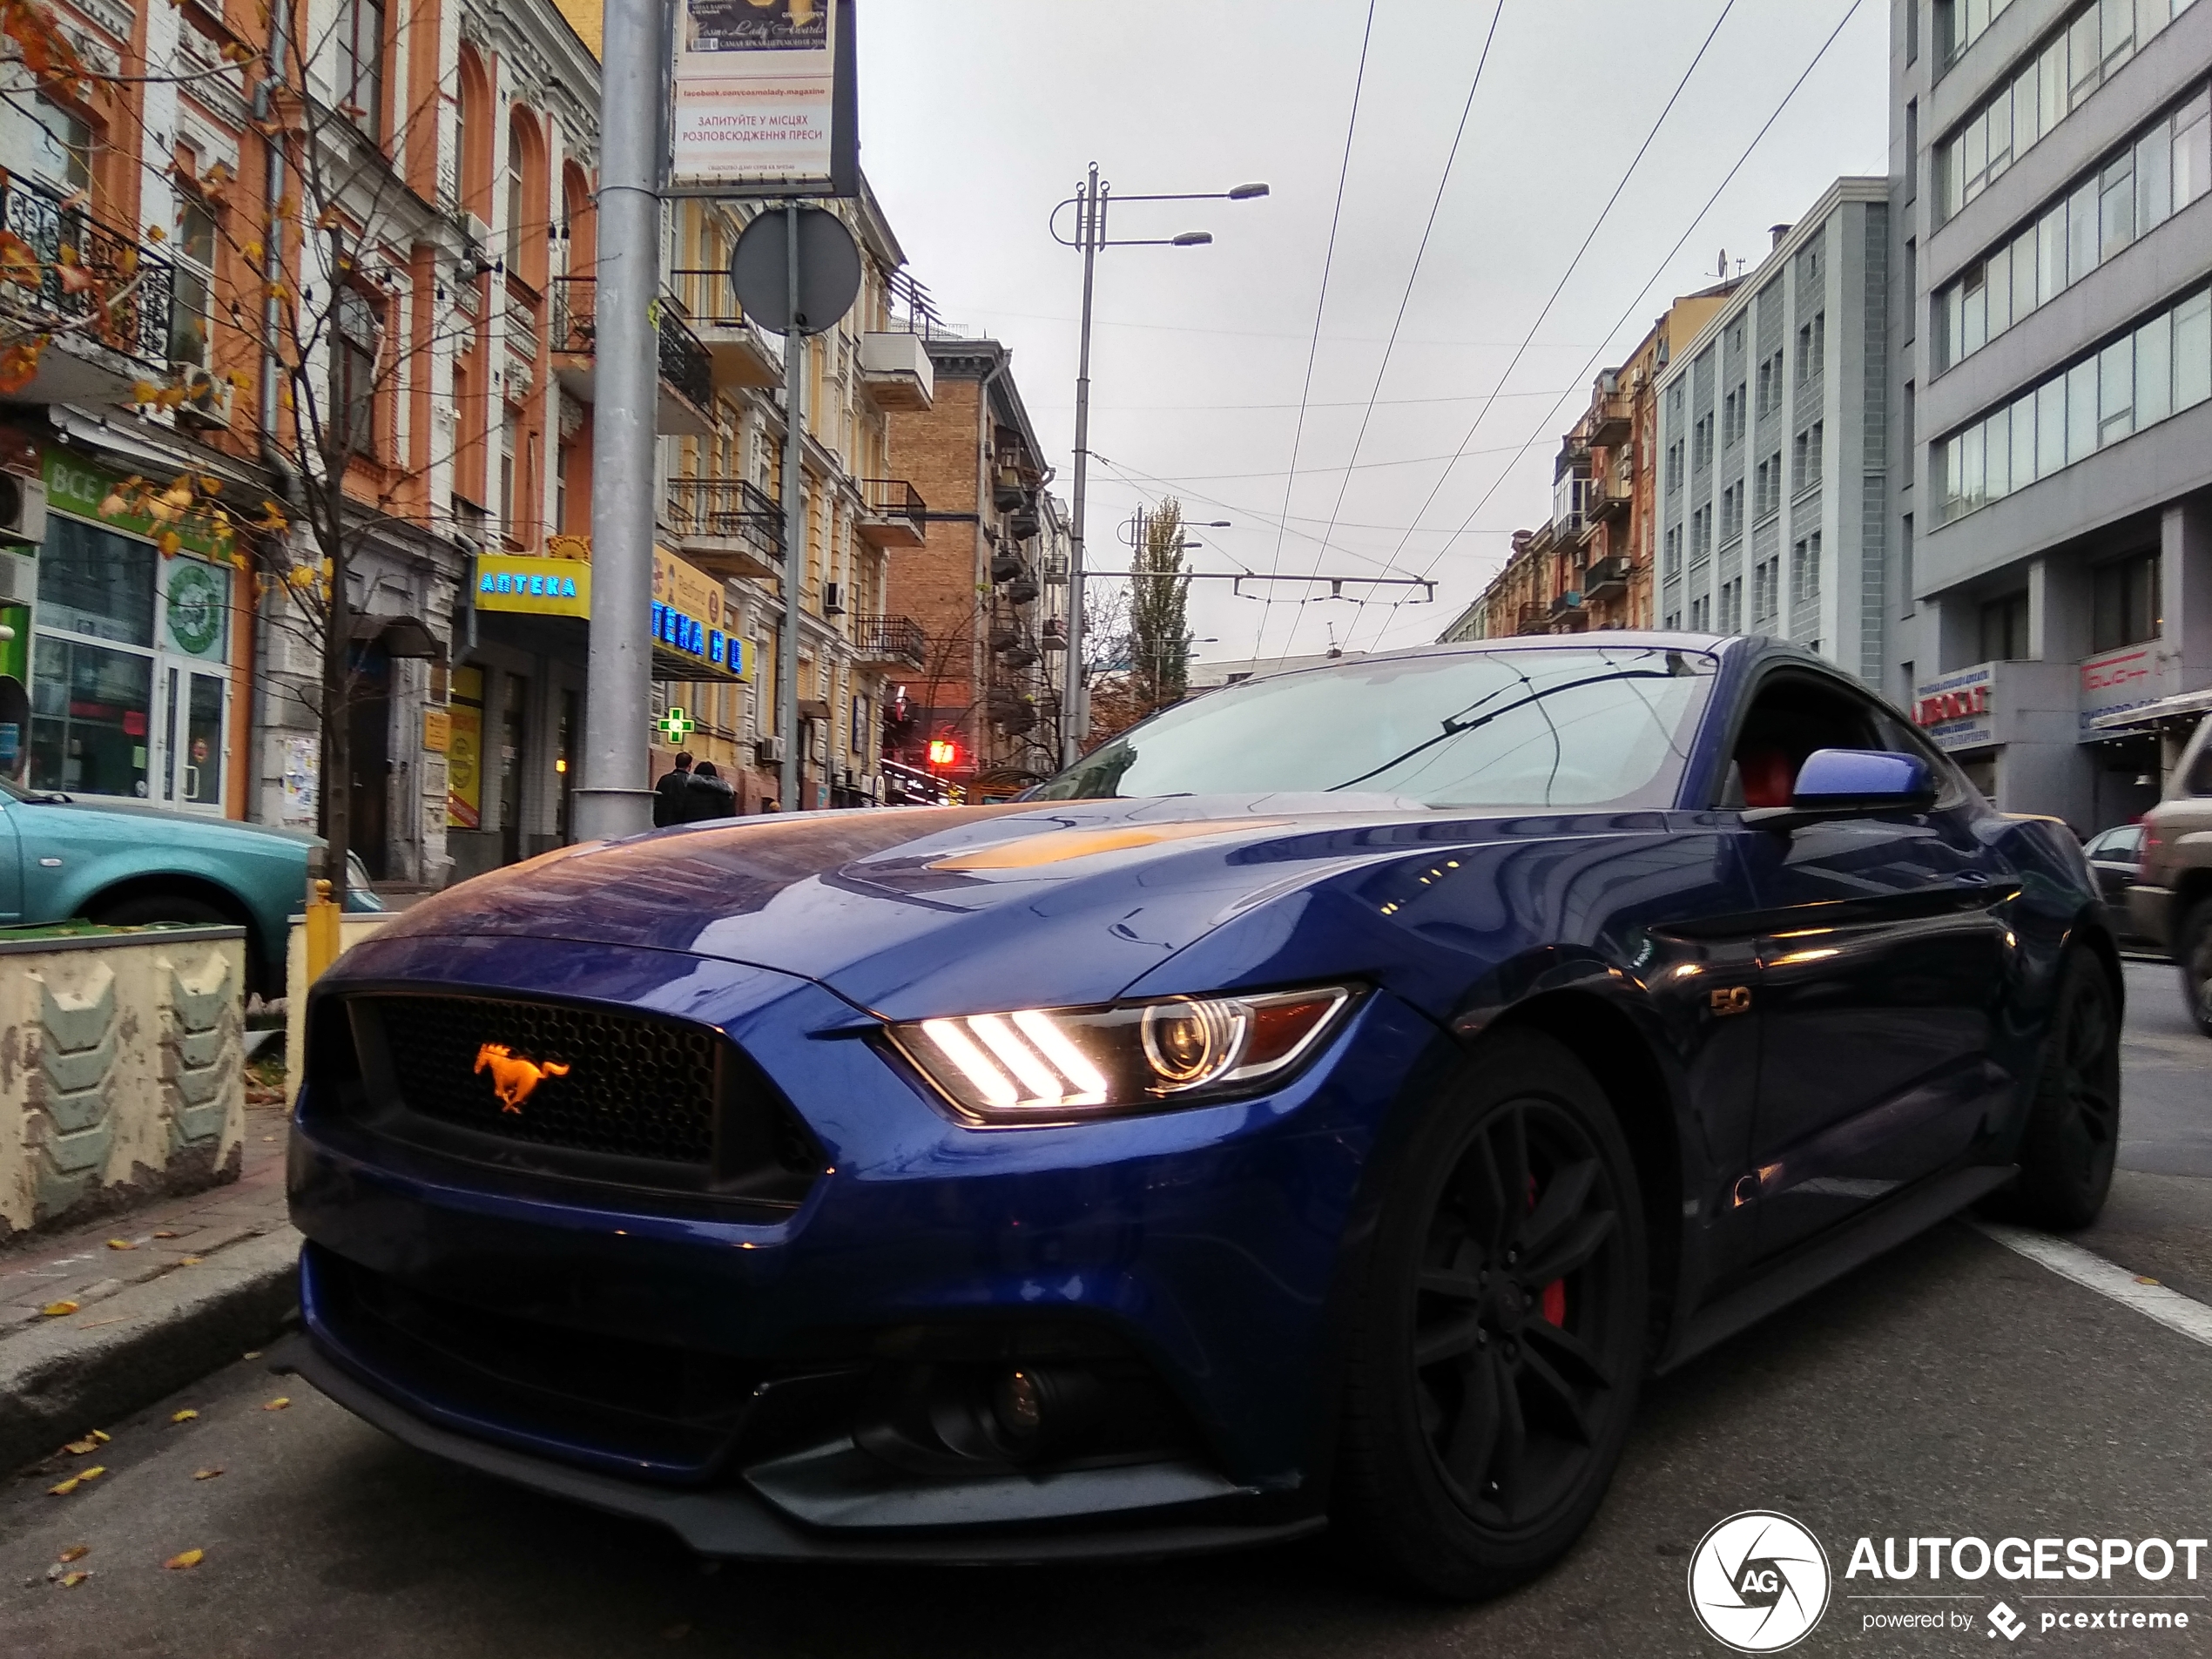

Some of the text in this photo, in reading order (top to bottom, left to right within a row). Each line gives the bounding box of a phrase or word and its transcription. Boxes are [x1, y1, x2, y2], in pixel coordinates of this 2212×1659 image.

[698, 114, 808, 126] ЗАПИТУЙТЕ У МІСЦЯХ
[683, 130, 823, 142] РОЗПОВСЮДЖЕННЯ ПРЕСИ
[51, 462, 98, 504] ВСЕ
[480, 572, 577, 597] АПТЕКА
[651, 598, 705, 657] ТЕКА
